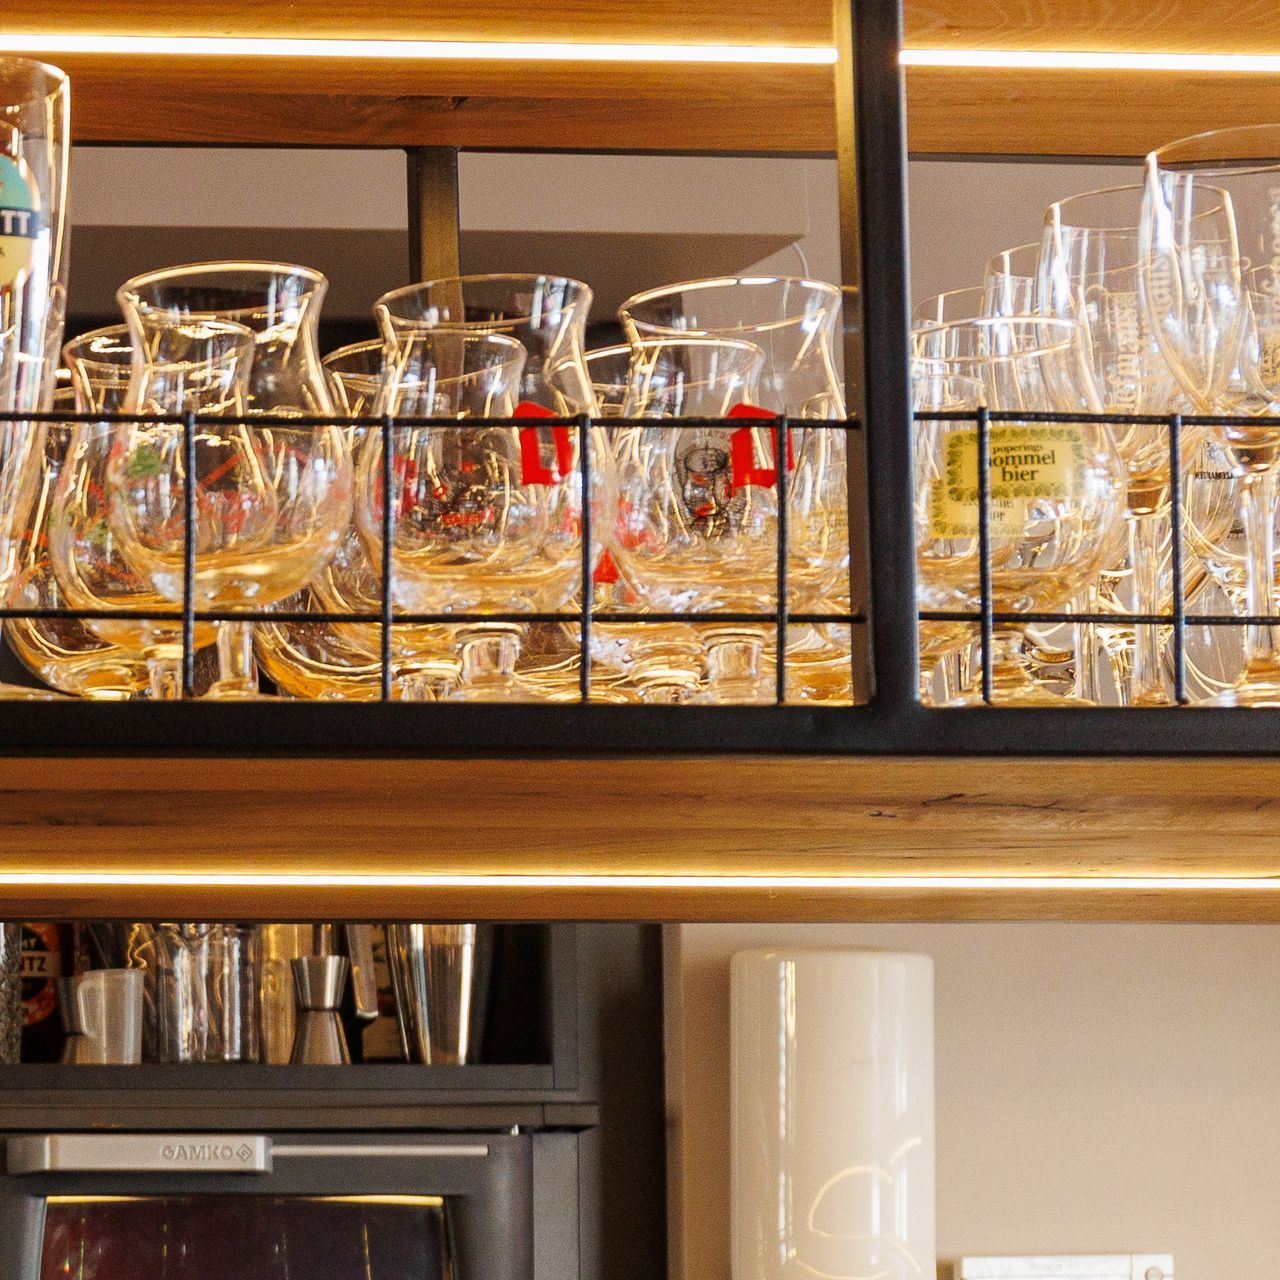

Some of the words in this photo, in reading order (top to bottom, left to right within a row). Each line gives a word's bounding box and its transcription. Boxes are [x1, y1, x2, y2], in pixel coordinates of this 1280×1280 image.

[989, 450, 1056, 467] ommel
[1002, 465, 1039, 482] bier
[161, 1145, 233, 1160] GAMKO
